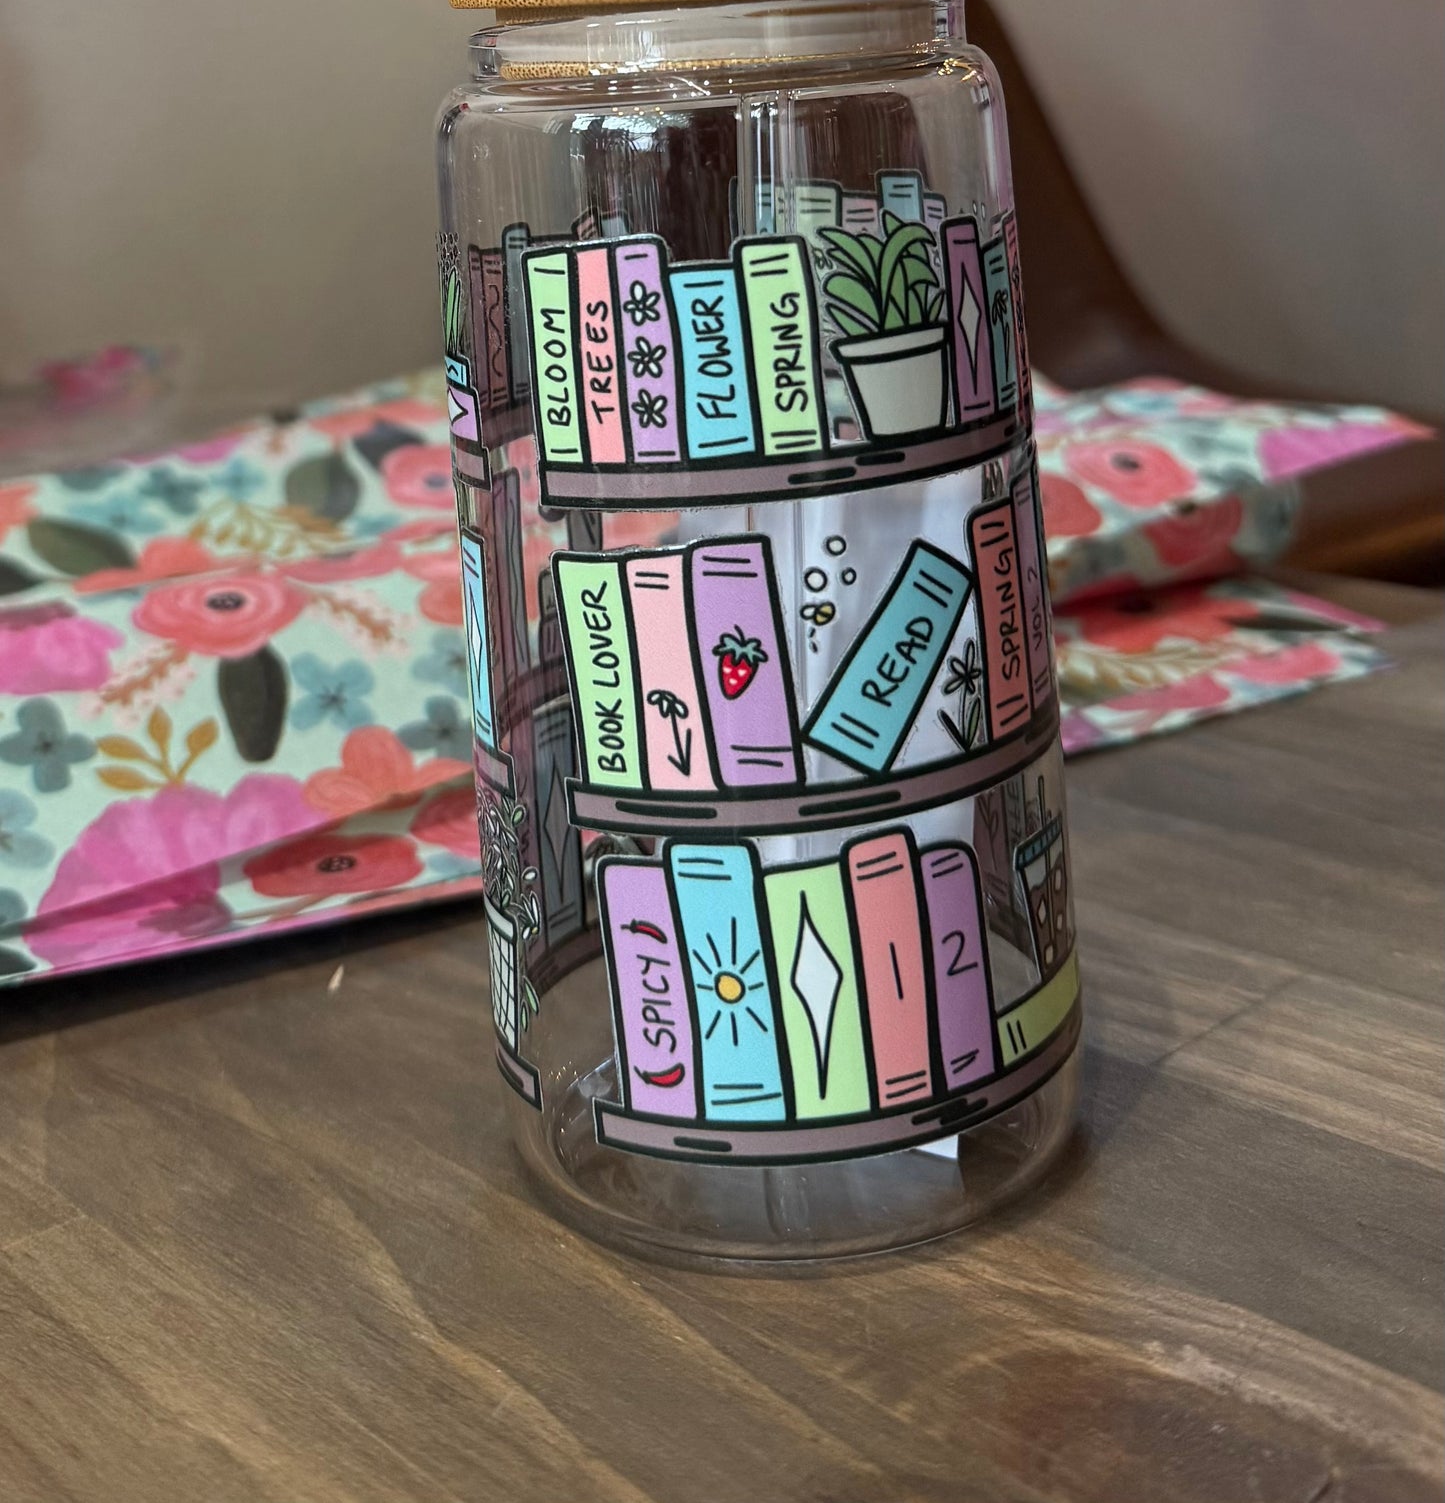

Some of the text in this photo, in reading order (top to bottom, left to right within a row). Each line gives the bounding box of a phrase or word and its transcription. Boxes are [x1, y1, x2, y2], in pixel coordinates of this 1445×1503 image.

[540, 307, 573, 427] BLOOM
[586, 299, 616, 424] TREES
[691, 297, 736, 420] FLOWER
[770, 292, 809, 413] SPRING
[994, 547, 1021, 681] SPRING
[1028, 558, 1038, 583] 2
[581, 581, 627, 773] BOOK LOVER
[861, 615, 932, 707] READ
[636, 954, 676, 1054] SPICY
[941, 930, 978, 977] 2
